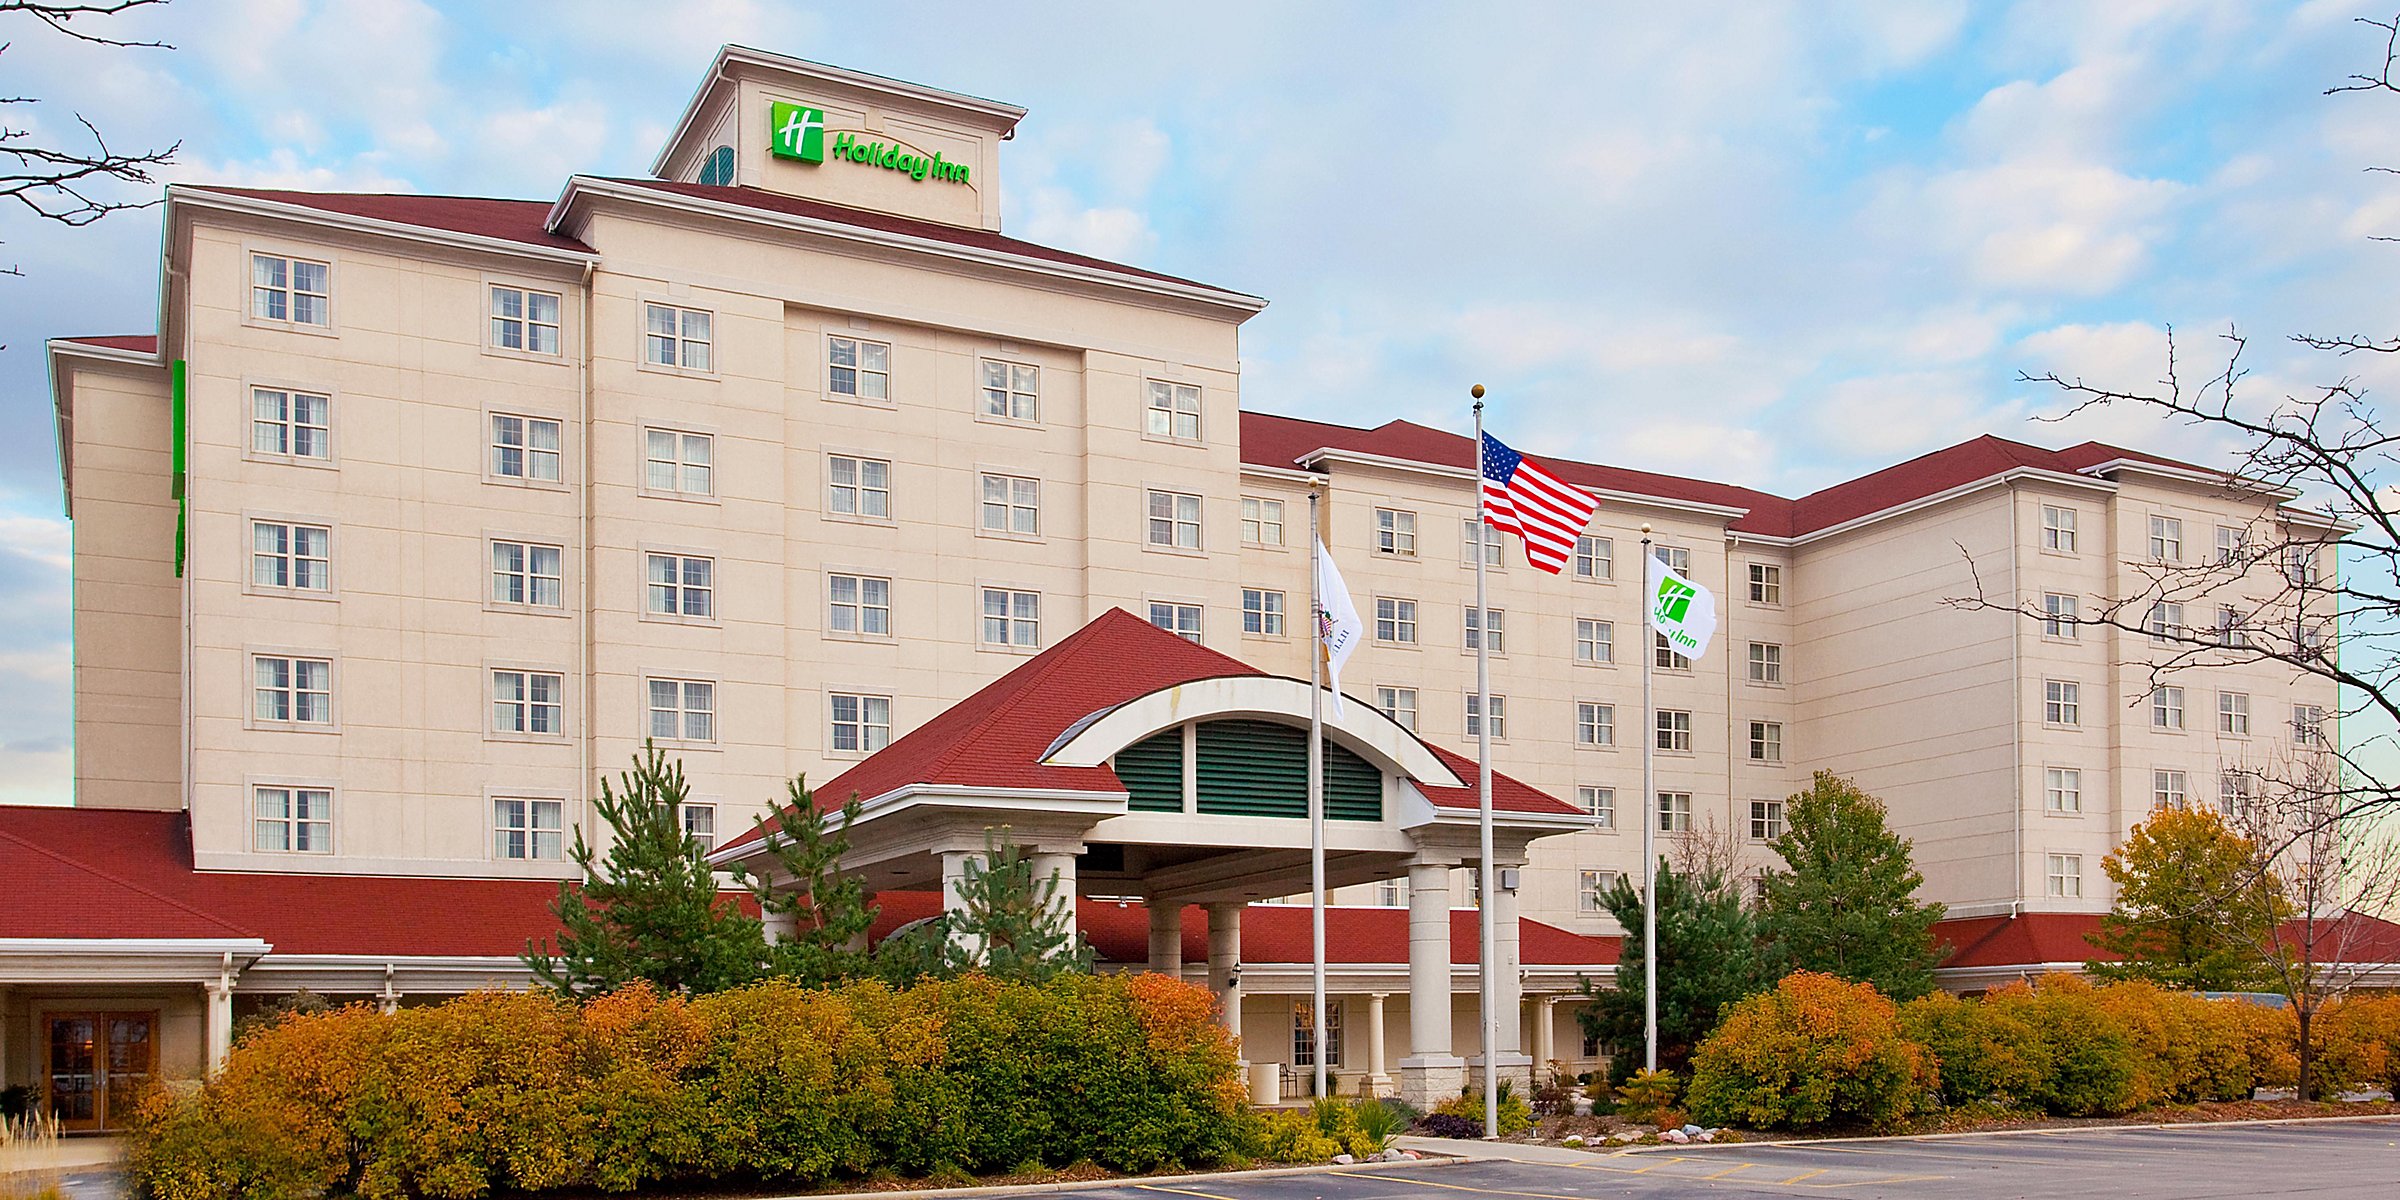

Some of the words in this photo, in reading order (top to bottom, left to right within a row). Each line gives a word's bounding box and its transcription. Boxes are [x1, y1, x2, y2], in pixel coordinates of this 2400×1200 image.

[833, 131, 929, 181] Holiday
[932, 151, 970, 183] Inn
[1675, 629, 1697, 649] Inn
